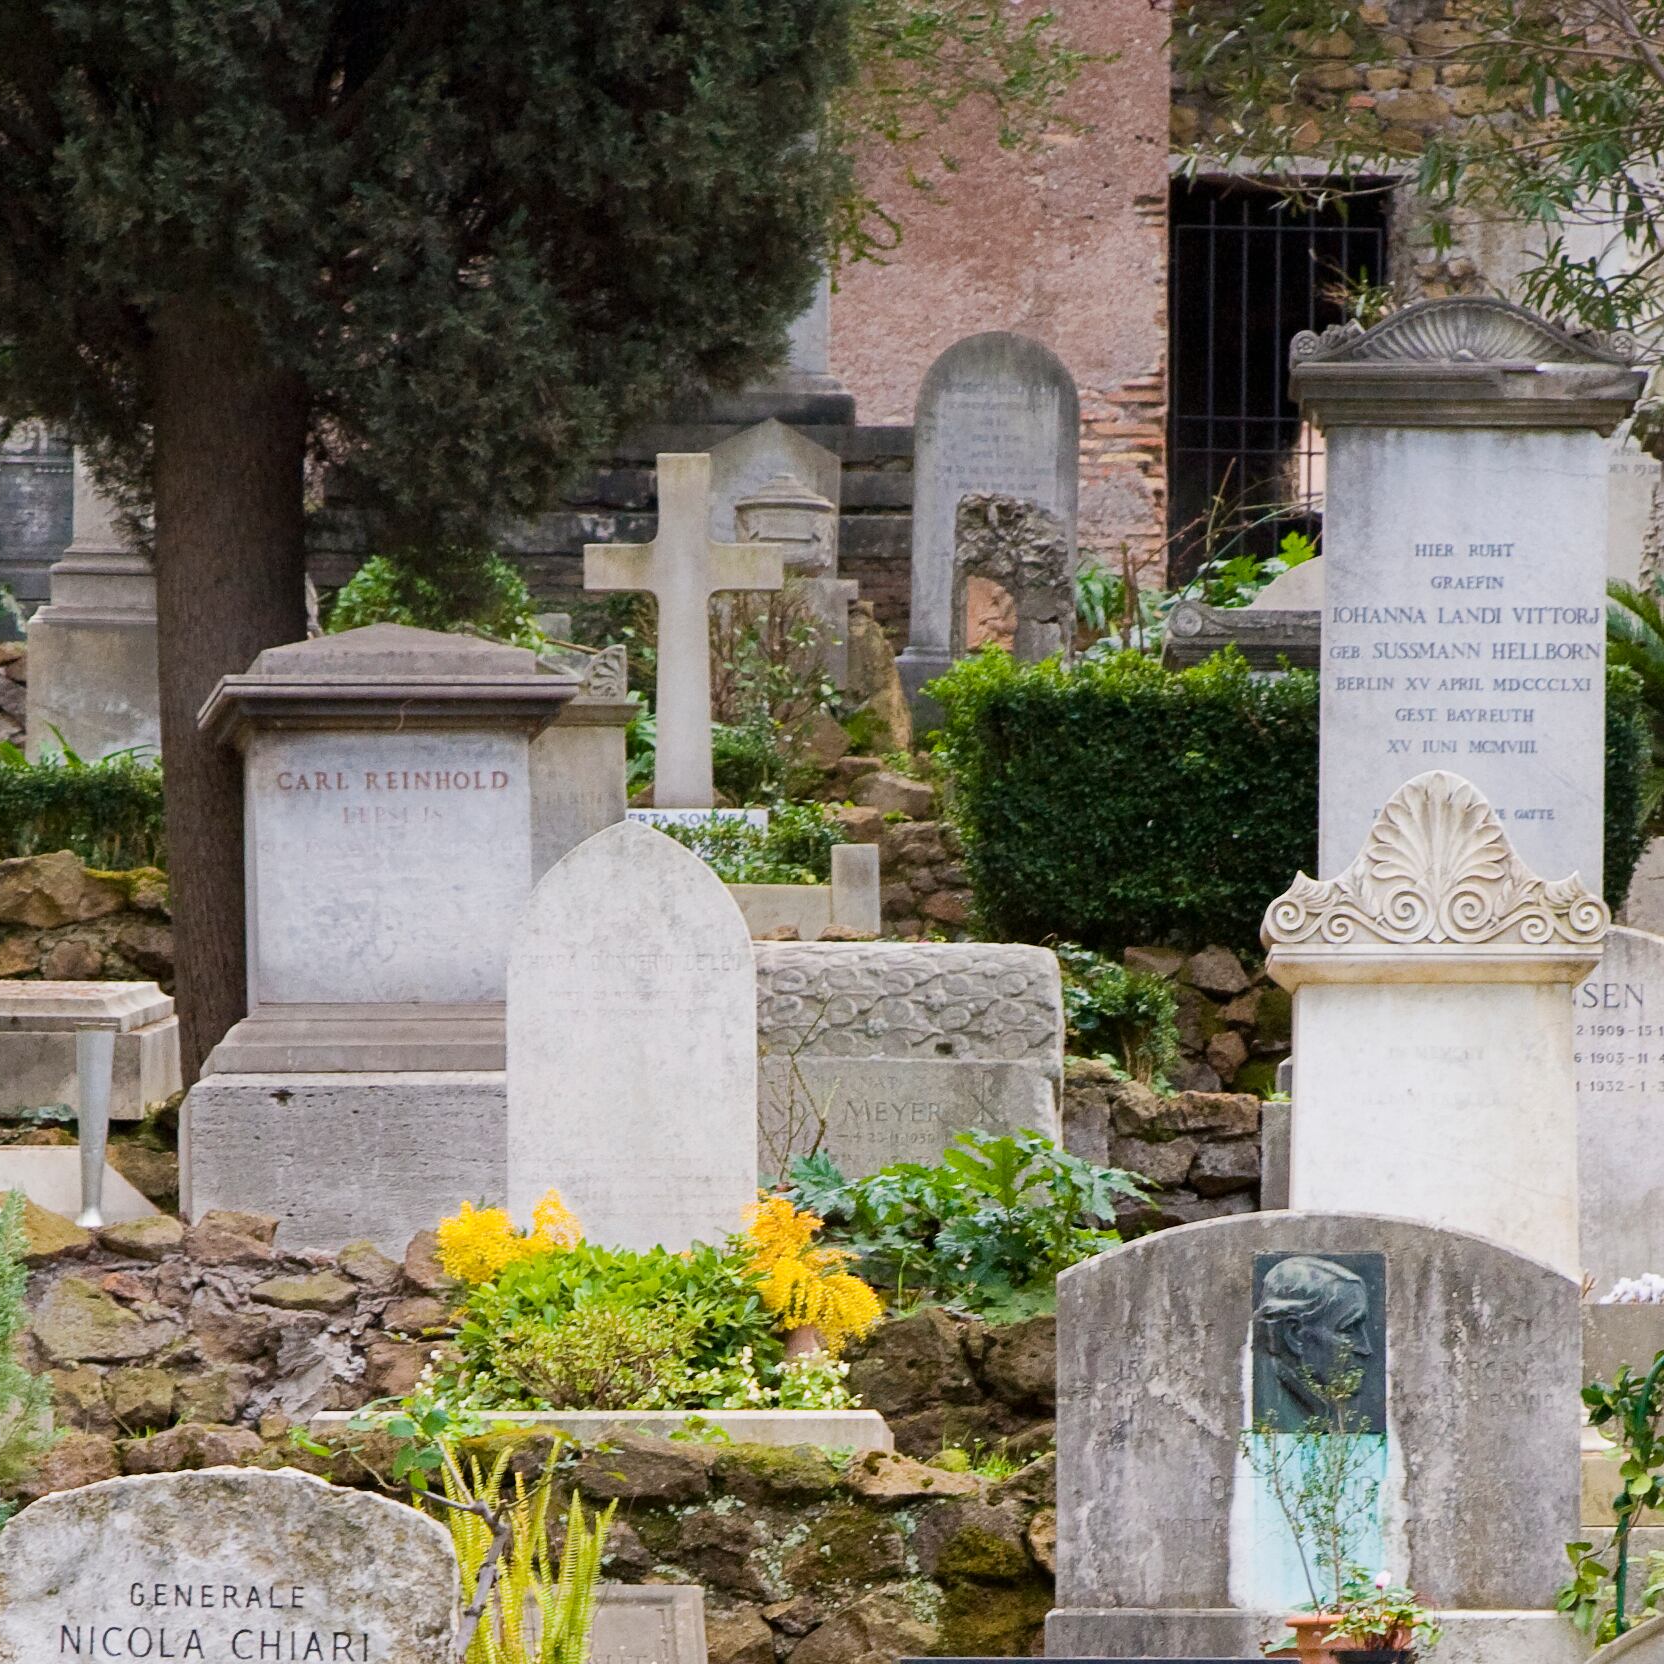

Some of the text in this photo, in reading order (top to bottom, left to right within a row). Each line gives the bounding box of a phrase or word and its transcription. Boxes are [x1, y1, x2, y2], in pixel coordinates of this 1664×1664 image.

[1415, 543, 1516, 557] HIER RUHT
[1430, 576, 1505, 590] GRAEFIN
[1438, 606, 1502, 625] LANDI
[1329, 642, 1602, 660] GEB SUSSMANN HELLBORN
[1335, 676, 1592, 692] BERLIN XV APRIL MDCCCLXI
[1446, 708, 1535, 723] BAYREUTH
[1386, 740, 1413, 754] XV
[277, 770, 510, 791] CARL REINHOLD
[1582, 982, 1645, 1009] SEN
[1590, 1025, 1625, 1037] 1909
[1638, 1025, 1652, 1037] 15
[1590, 1081, 1625, 1093] 1932
[844, 1101, 943, 1122] MEYER
[130, 1582, 306, 1610] GENERALE
[59, 1624, 371, 1663] NICOLA CHIARI
